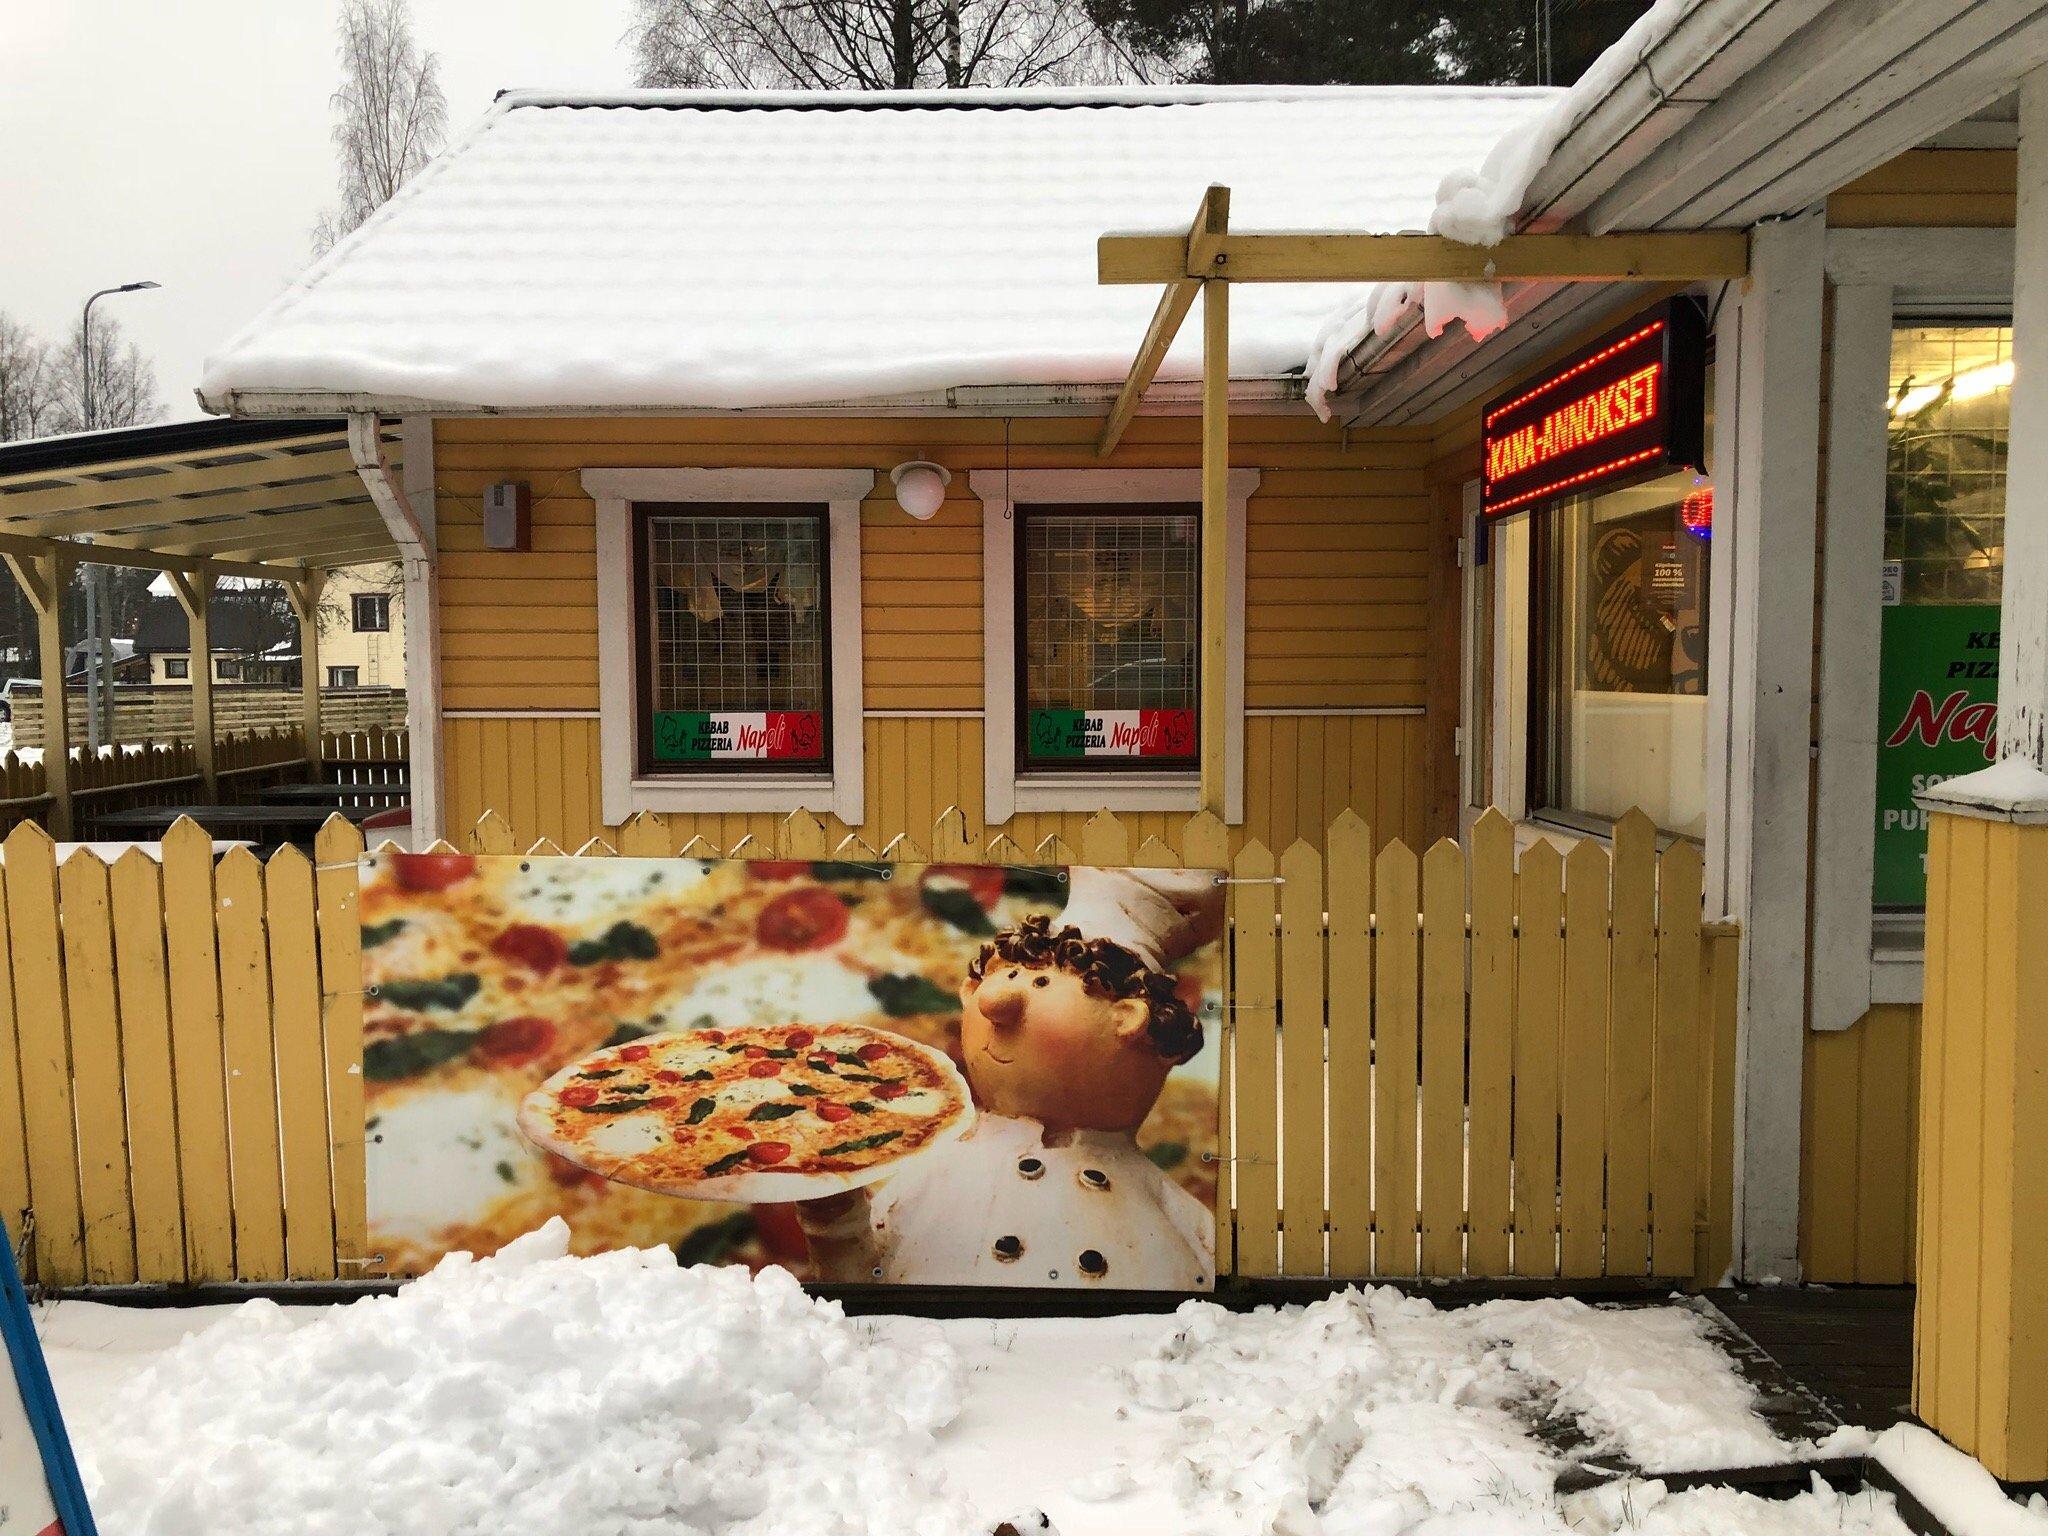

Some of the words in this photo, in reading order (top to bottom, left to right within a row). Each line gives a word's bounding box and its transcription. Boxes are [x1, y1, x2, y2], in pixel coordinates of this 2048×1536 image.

[1491, 363, 1661, 482] KANA-ANNOKSET
[1655, 568, 1671, 577] 100
[1673, 568, 1683, 577] %
[1966, 632, 2000, 649] KE
[1946, 662, 1999, 678] PIZ
[698, 721, 729, 735] KEBAB
[1073, 719, 1103, 732] KEBAB
[1110, 711, 1159, 755] Napoli
[736, 713, 786, 757] Napoli
[1067, 735, 1106, 748] PIZZERIA
[692, 738, 732, 751] PIZZERIA
